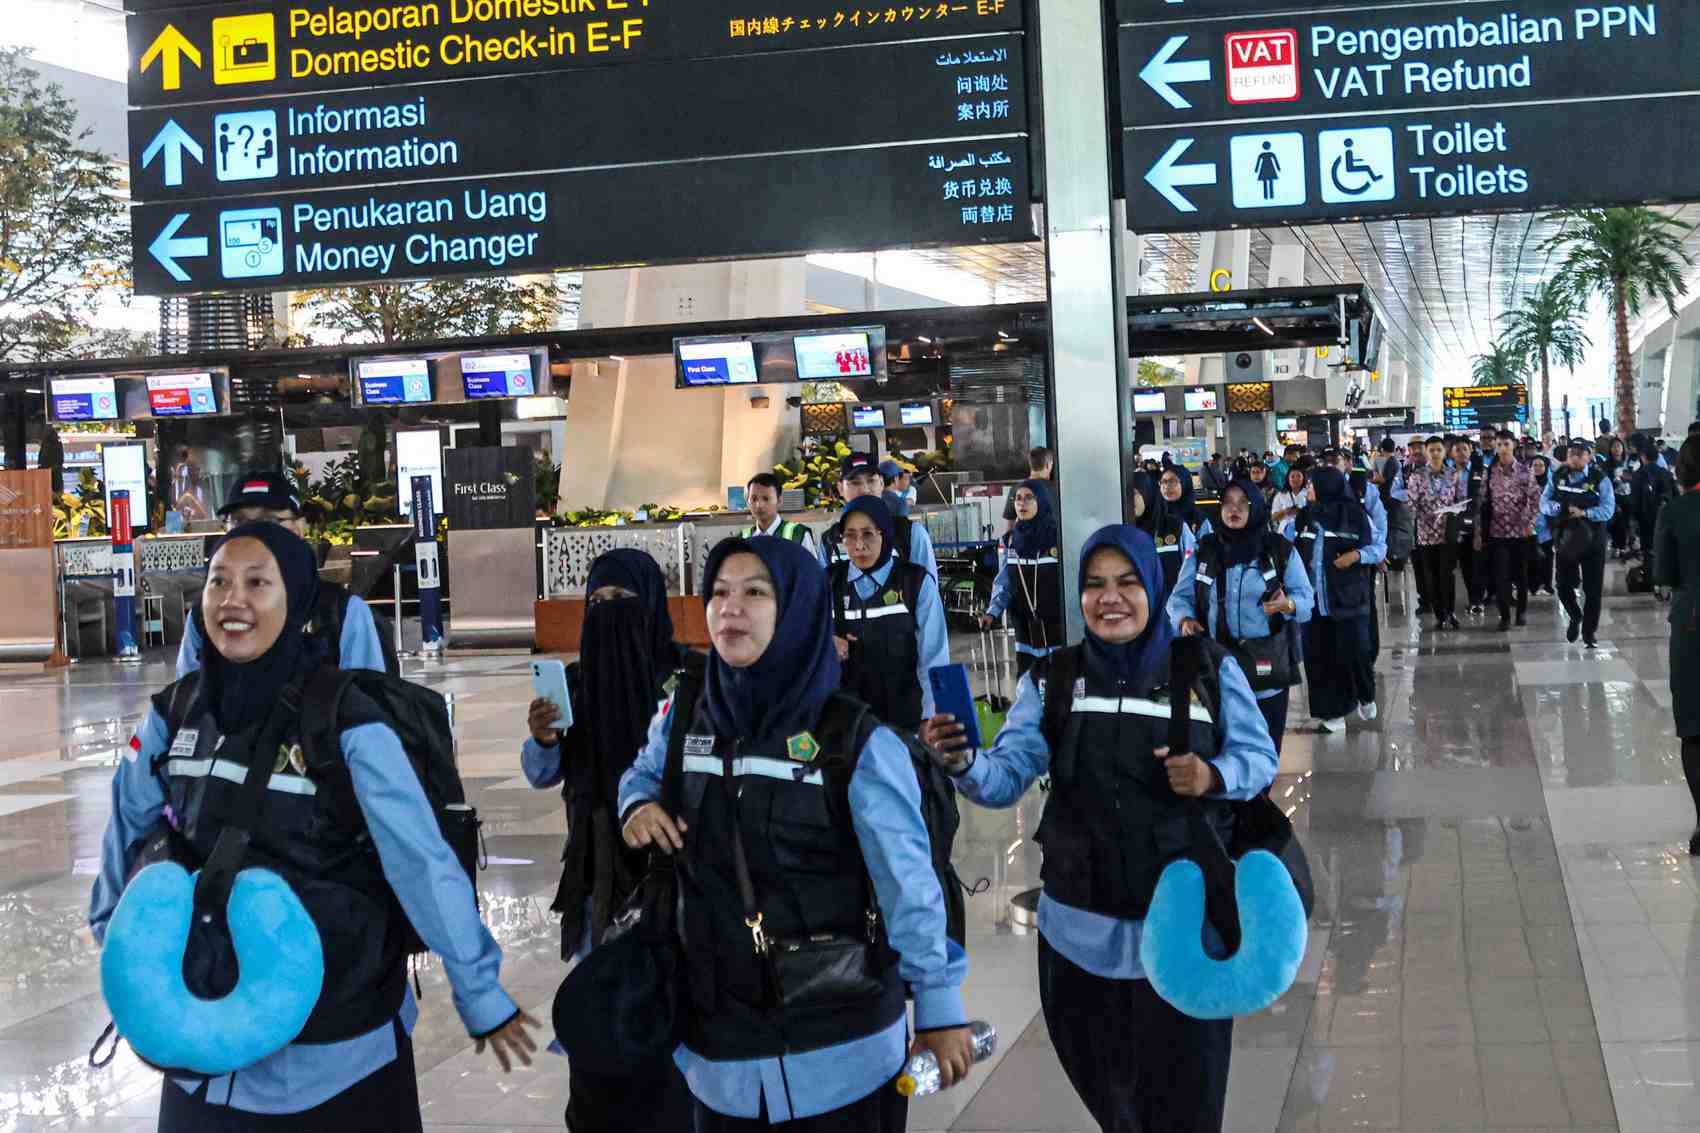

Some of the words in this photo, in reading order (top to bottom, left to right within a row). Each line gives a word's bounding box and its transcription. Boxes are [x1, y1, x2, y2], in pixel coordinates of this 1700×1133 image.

[290, 5, 438, 39] Pelaporan
[729, 5, 968, 37] 国内線チェックインカウンター
[1311, 15, 1563, 59] Pengembalian
[1575, 4, 1656, 39] PPN
[290, 38, 431, 78] Domestic
[440, 26, 576, 65] Check-in
[587, 18, 643, 52] E-F
[1235, 39, 1287, 63] VAT
[957, 73, 1009, 95] 问询处
[1314, 64, 1392, 98] VAT
[1403, 56, 1532, 94] Refund
[288, 97, 426, 136] Informasi
[957, 100, 1009, 121] 案内所
[1406, 122, 1507, 156] Toilet
[289, 138, 458, 176] Information
[943, 177, 1012, 200] 货币兑换
[1408, 163, 1529, 198] Toilets
[294, 198, 453, 233] Penukaran
[463, 188, 547, 221] Uang
[961, 204, 1013, 225] 両替店
[295, 242, 396, 274] Money
[405, 232, 538, 266] Changer
[1211, 269, 1231, 293] C
[454, 483, 478, 495] First
[480, 482, 507, 494] Class
